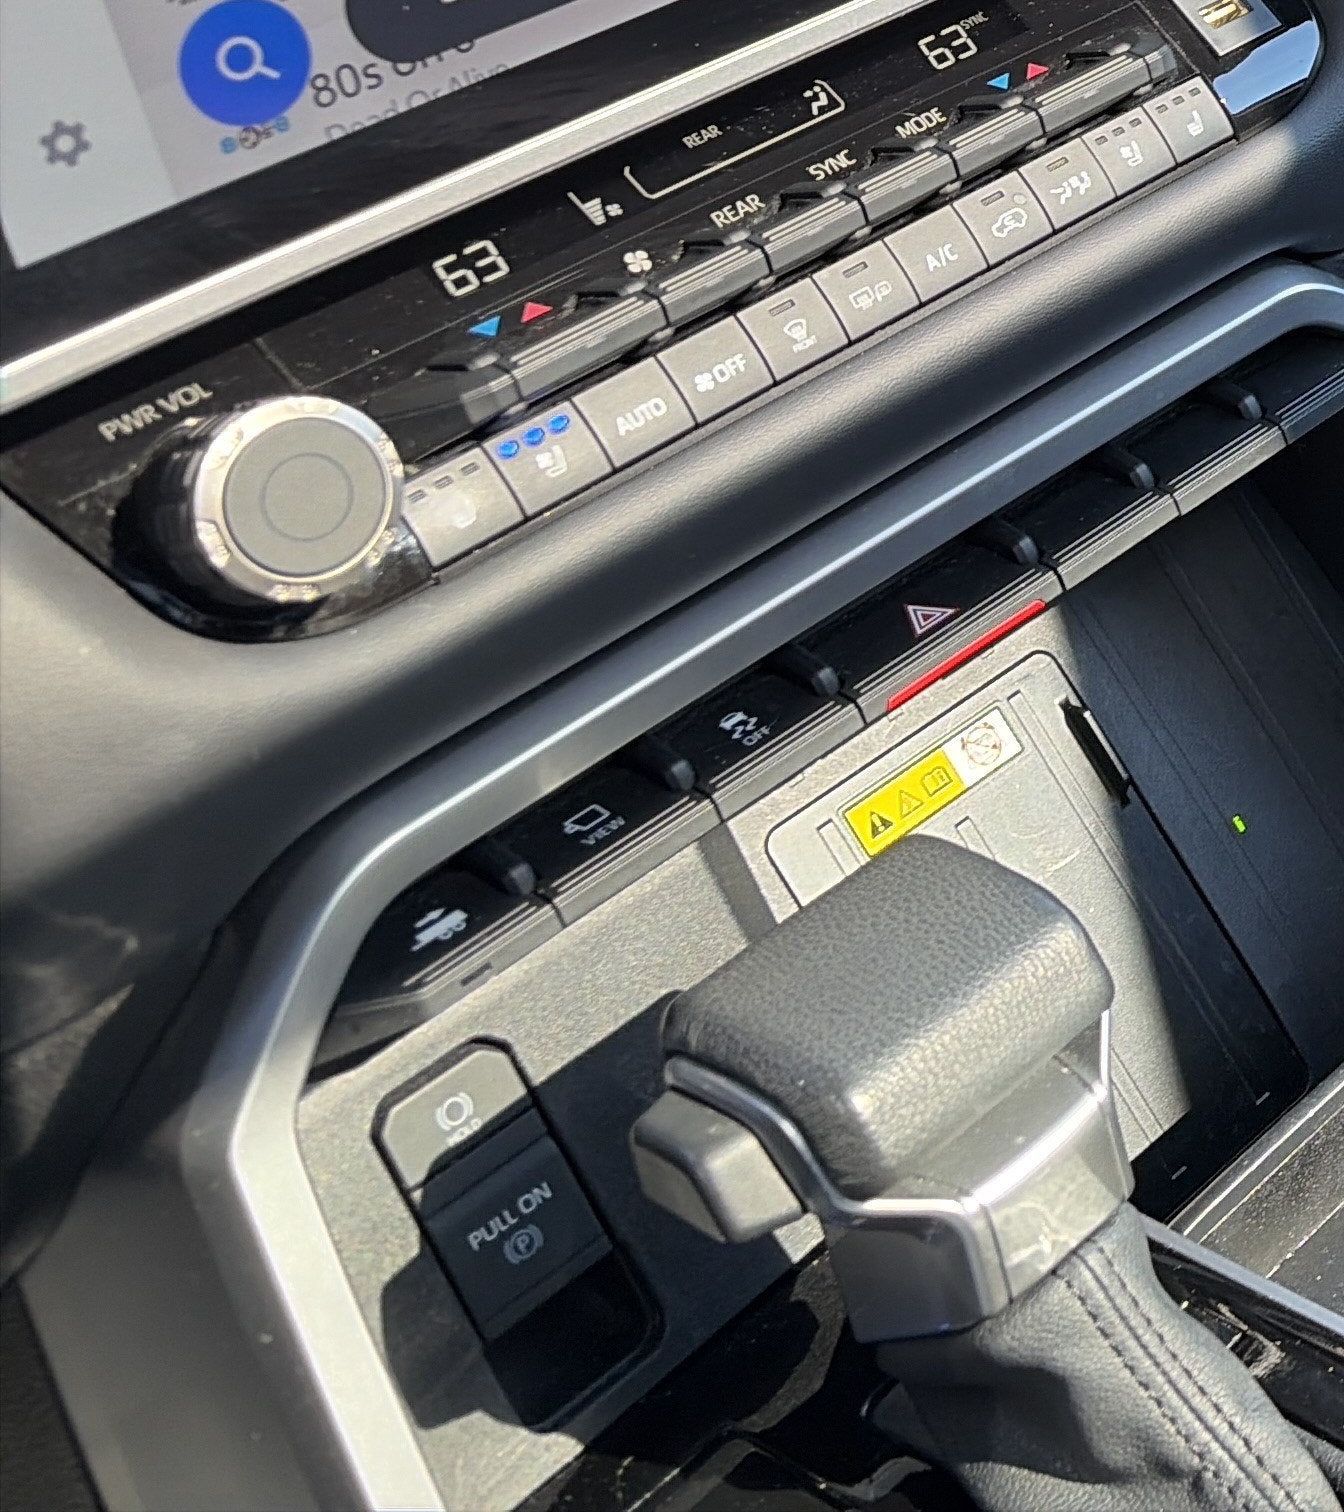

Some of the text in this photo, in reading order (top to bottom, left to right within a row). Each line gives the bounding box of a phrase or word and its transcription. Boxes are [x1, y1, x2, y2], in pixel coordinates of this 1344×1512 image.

[918, 9, 990, 71] 63 SYNC
[310, 62, 384, 108] 80s
[682, 124, 723, 149] REAR
[896, 106, 948, 139] MODE
[807, 149, 858, 182] SYNC
[710, 194, 765, 230] REAR
[433, 238, 510, 297] 63
[925, 242, 959, 273] A/C
[714, 353, 747, 383] OFF
[98, 382, 213, 443] PWR VOL
[614, 396, 668, 436] AUTO
[742, 724, 770, 746] OFF
[581, 817, 625, 846] VIEW
[467, 1181, 552, 1252] PULL ON
